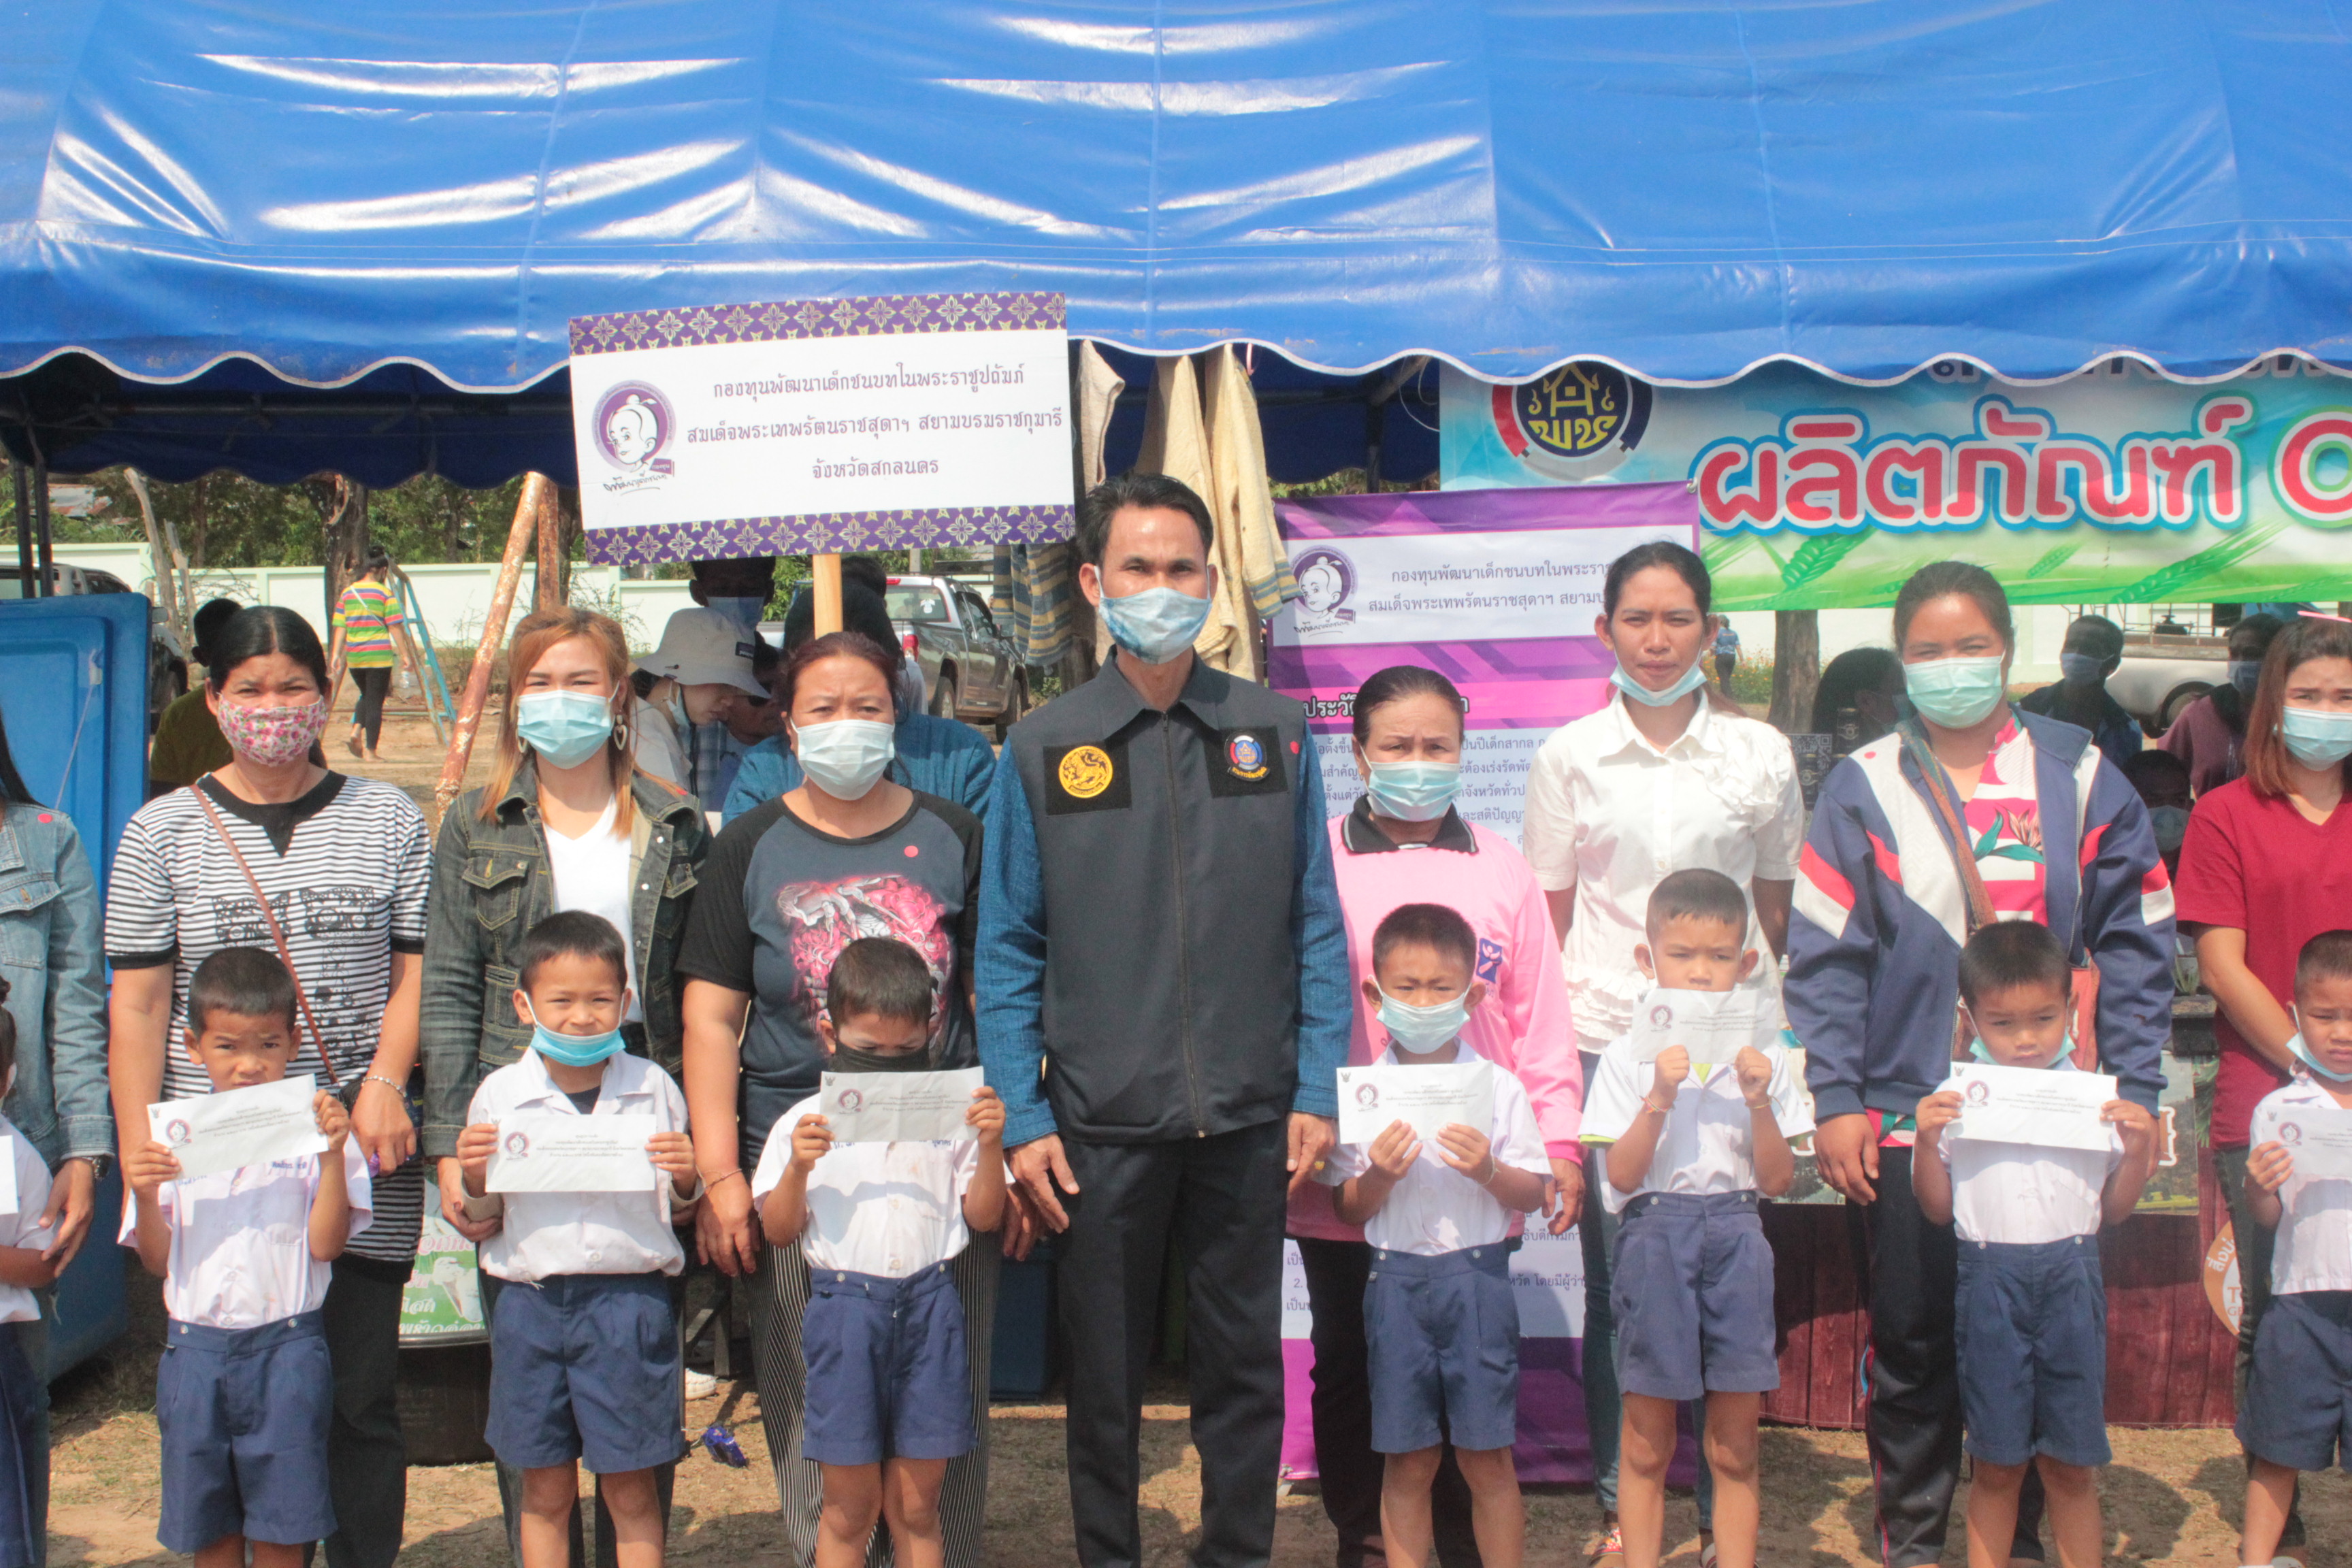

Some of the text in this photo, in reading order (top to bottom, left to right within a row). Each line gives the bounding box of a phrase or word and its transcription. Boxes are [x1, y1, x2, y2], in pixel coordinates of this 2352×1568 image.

[713, 361, 1025, 403] กองทุนพัฒนาเด็กชนบทในพระราชูปถัมภ์
[687, 406, 1062, 444] สมเด็จพระเทพรัตนราชสุดาฯ สยามบรมราชกุมารี
[811, 457, 939, 479] จังหวัดสกลนคร
[1697, 402, 2247, 525] ผลิตภัณฑ์
[1391, 559, 1612, 587] กองทุนพัฒนาเด็กชนบทในพระรา
[1369, 591, 1554, 612] สมเด็จพระเทพรัตนราชสุดาฯ
